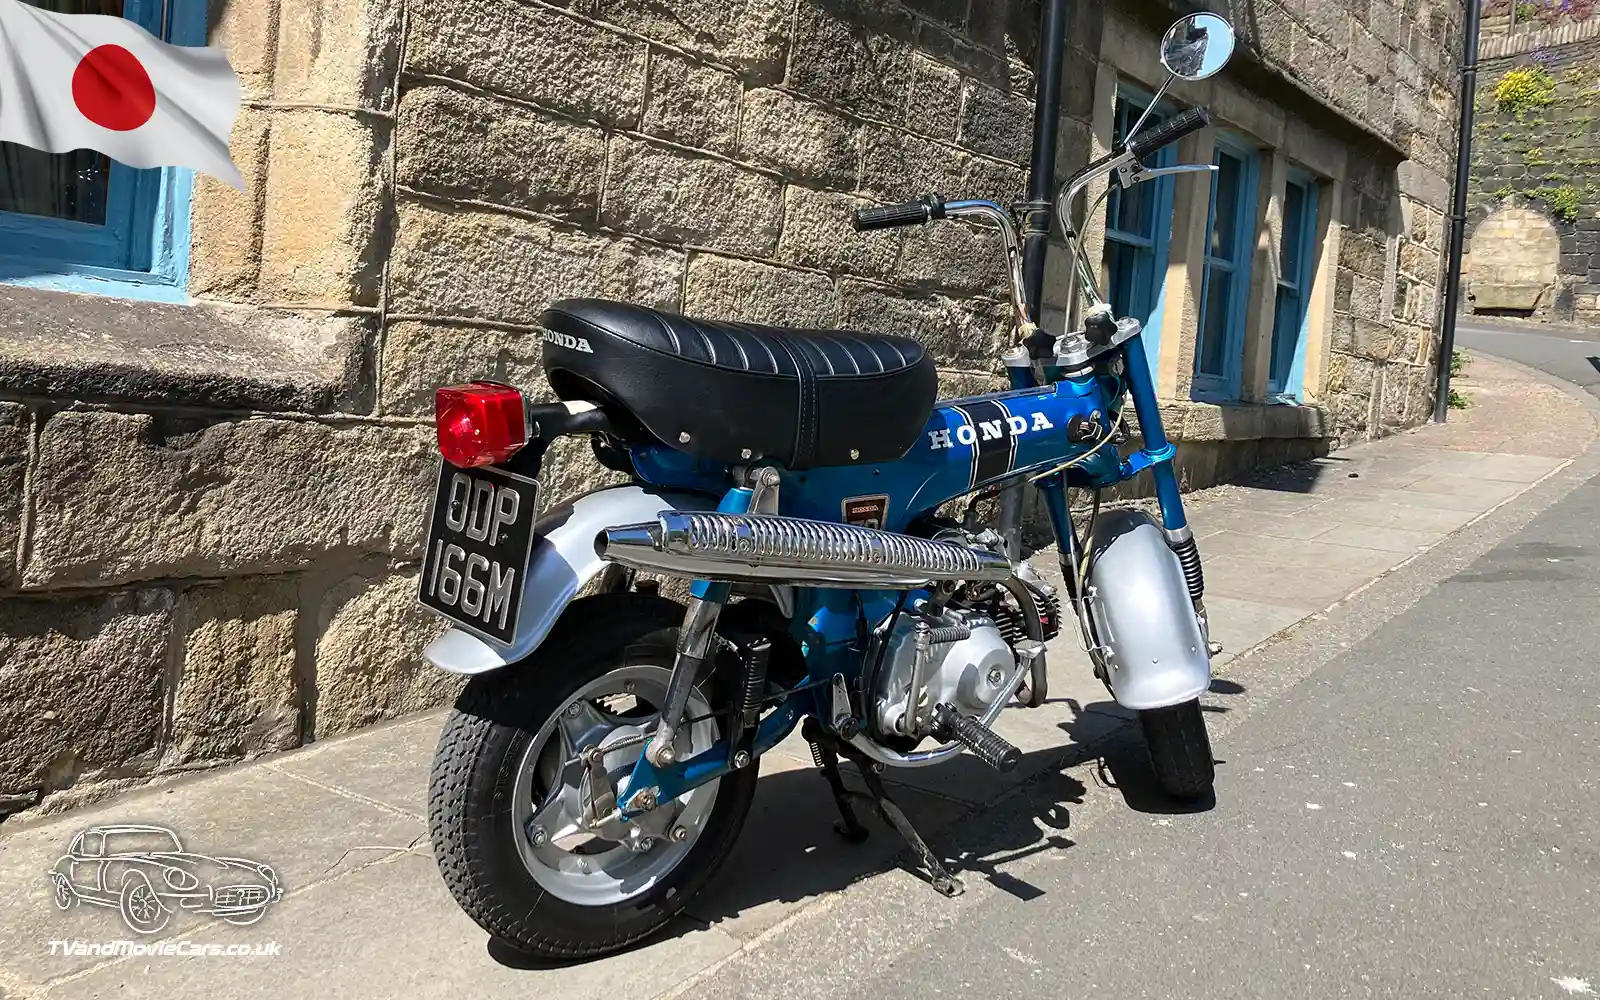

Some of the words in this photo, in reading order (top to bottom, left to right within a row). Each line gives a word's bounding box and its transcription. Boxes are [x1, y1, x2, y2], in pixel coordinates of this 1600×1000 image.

[928, 411, 1054, 450] HONDA
[445, 472, 520, 547] ODP
[428, 538, 516, 630] 166M
